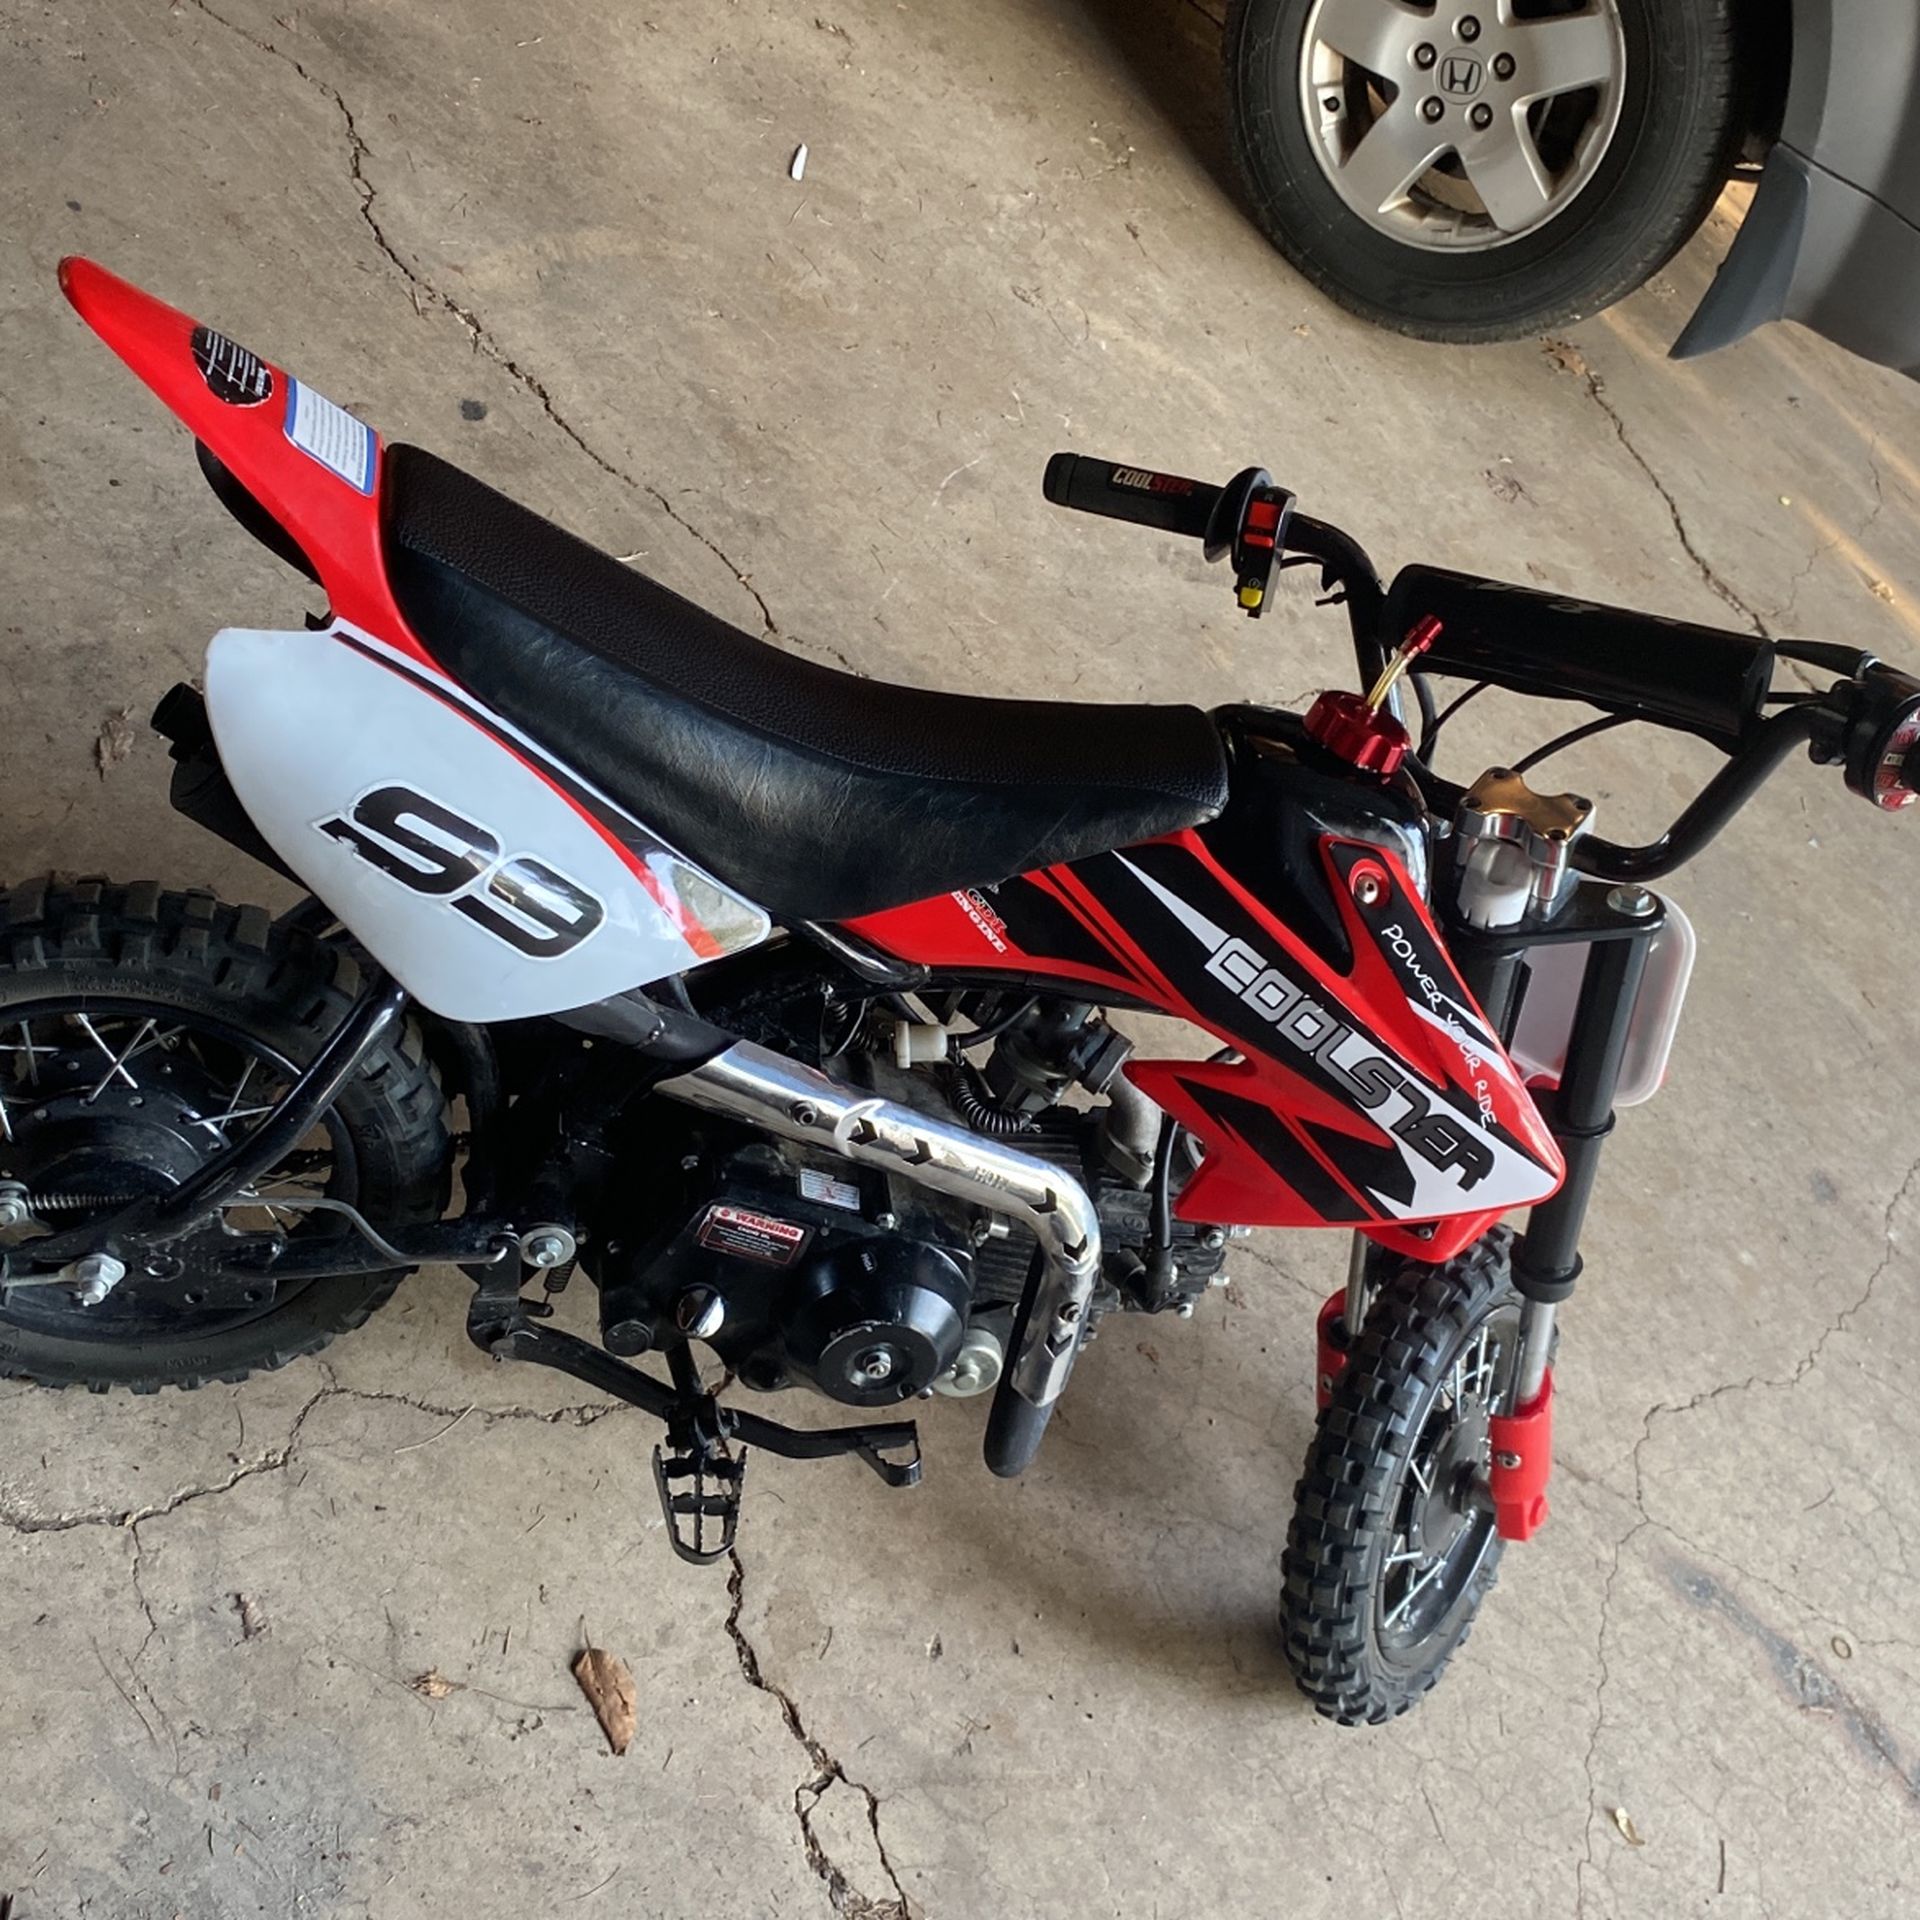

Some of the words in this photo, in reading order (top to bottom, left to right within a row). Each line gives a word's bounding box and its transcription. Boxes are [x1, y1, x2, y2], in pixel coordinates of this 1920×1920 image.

[1203, 937, 1495, 1192] COOLSTER
[1381, 924, 1443, 1012] POWER
[1446, 1013, 1481, 1077] YOUR
[1474, 1079, 1497, 1129] RIDE
[735, 1211, 800, 1238] WARNING
